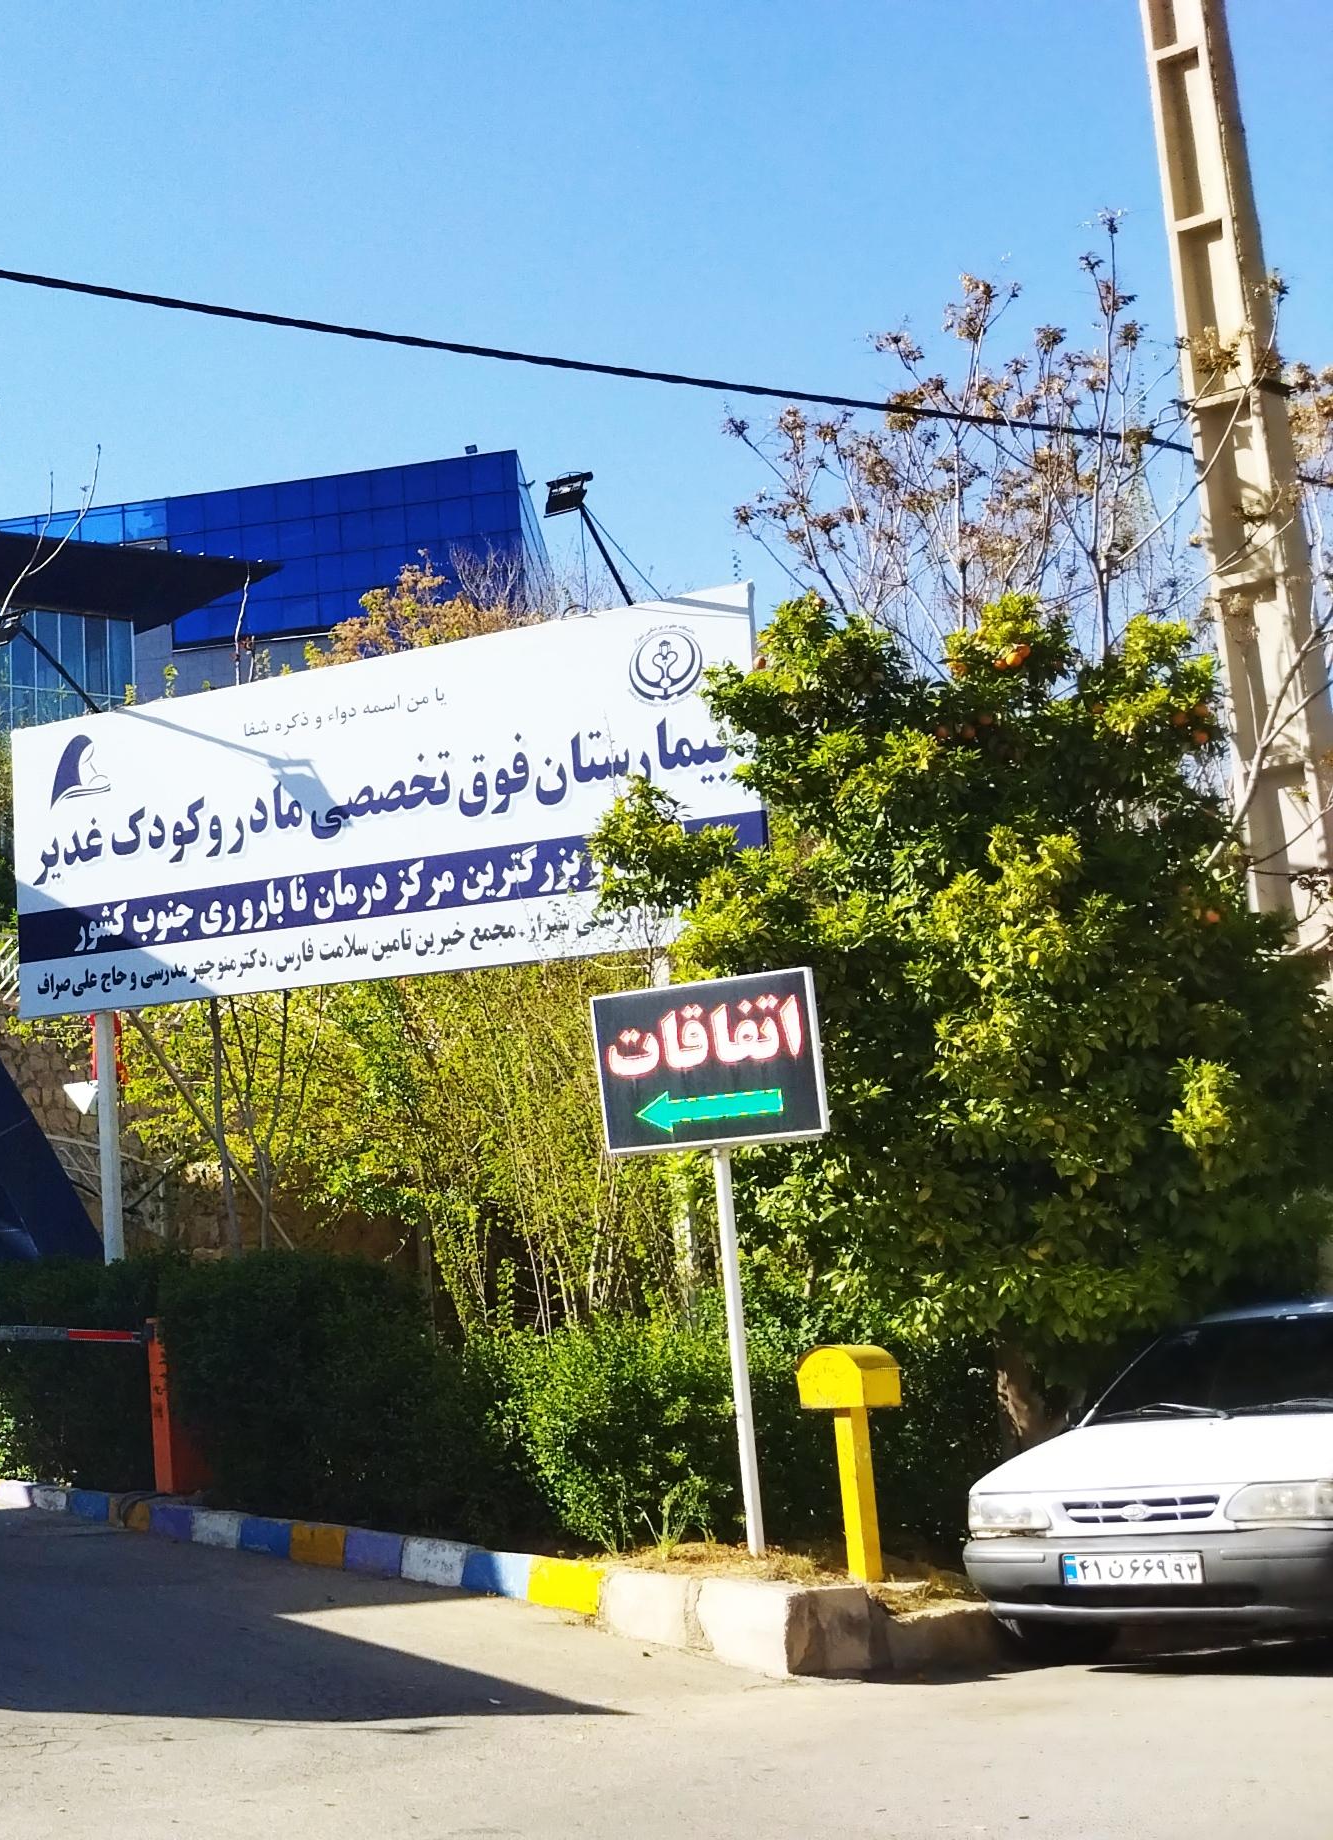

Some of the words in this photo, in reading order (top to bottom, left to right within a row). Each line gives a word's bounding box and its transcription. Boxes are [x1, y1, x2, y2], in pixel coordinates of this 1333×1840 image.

[363, 694, 401, 714] اسمه
[407, 695, 429, 712] من
[435, 687, 447, 705] یا
[243, 719, 269, 737] شفا
[275, 711, 309, 735] ذکره
[315, 716, 322, 729] و
[459, 732, 531, 817] فوق
[535, 716, 728, 806] بیمارستان
[311, 750, 451, 840] تخصصی
[111, 796, 205, 864] کودک
[227, 781, 302, 855] مادر
[32, 816, 104, 886] غدیر
[205, 814, 222, 857] و
[394, 860, 456, 911] مرکز
[462, 844, 581, 900] بزرگترین
[313, 870, 388, 920] درمان
[74, 902, 128, 951] کشور
[133, 902, 195, 942] جنوب
[415, 921, 465, 956] خیرین
[470, 923, 516, 950] مجمع
[318, 933, 369, 962] سلامت
[372, 927, 412, 962] تامین
[100, 965, 128, 993] حاج
[140, 965, 187, 989] مدرسی
[190, 951, 237, 983] منوچهر
[237, 948, 267, 977] دکتر
[37, 972, 71, 1000] صراف
[72, 968, 98, 997] علی
[129, 971, 136, 990] و
[607, 994, 803, 1077] اتفاقات
